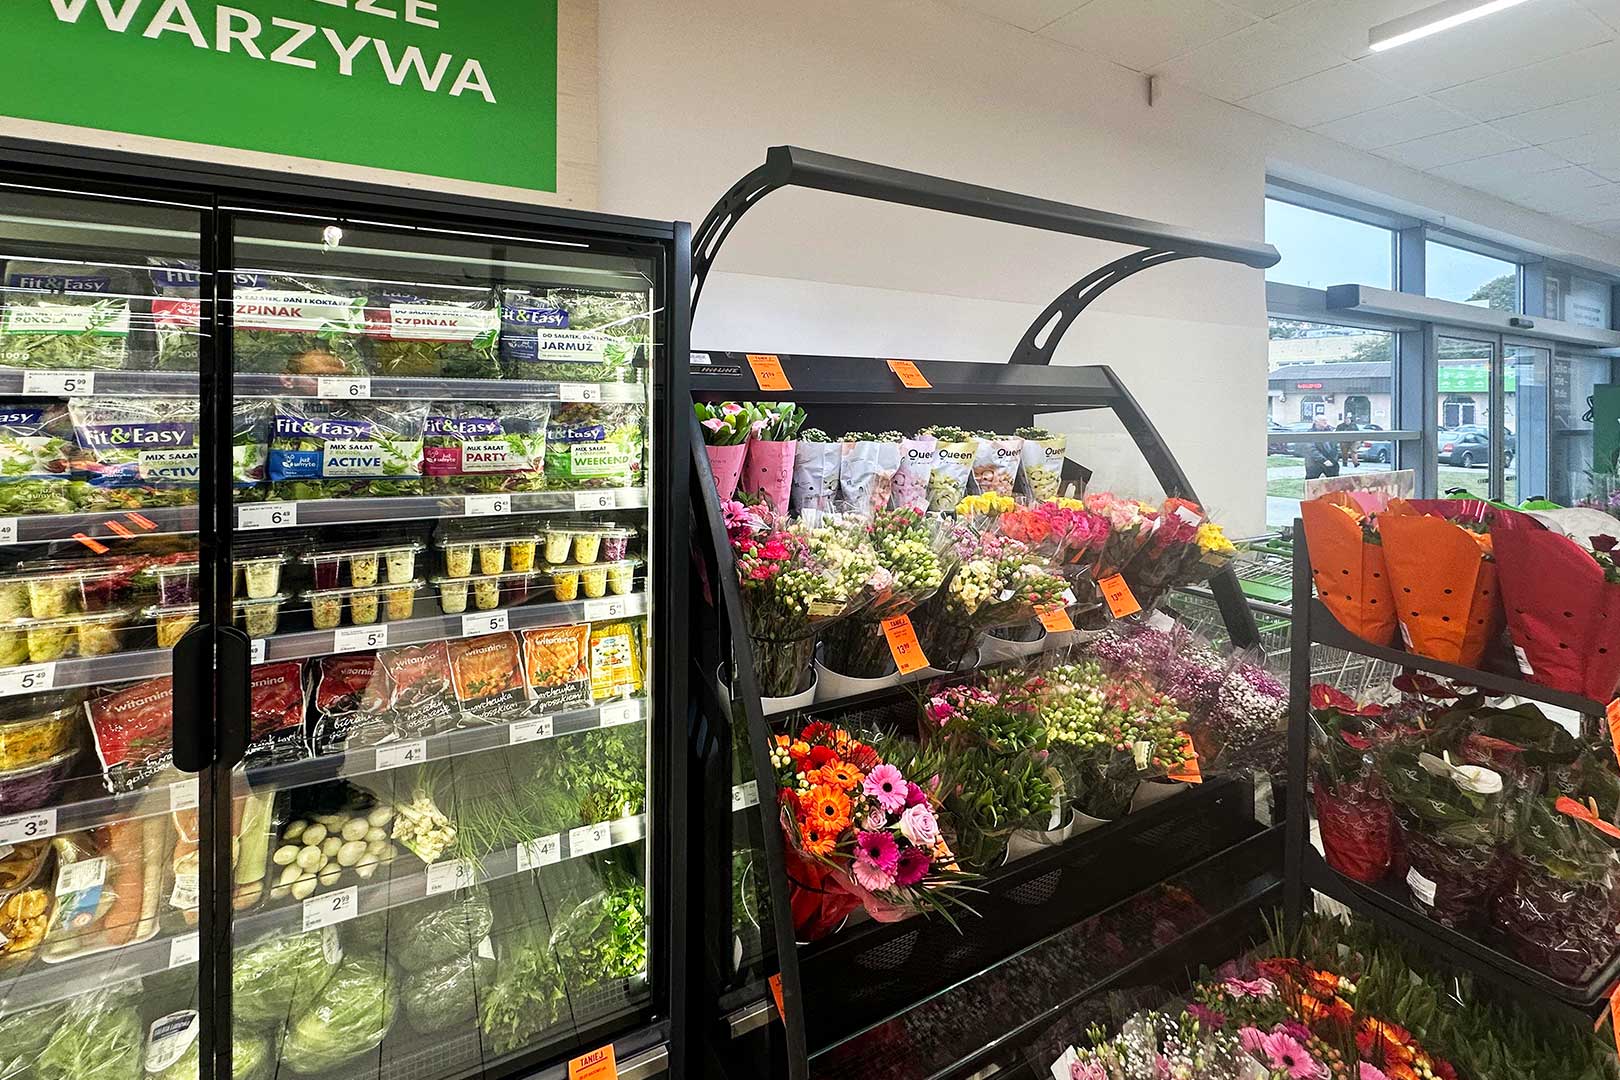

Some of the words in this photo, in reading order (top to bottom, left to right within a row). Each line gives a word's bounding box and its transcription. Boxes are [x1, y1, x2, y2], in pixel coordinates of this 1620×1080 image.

[235, 304, 303, 318] ZPINAK
[541, 341, 593, 352] JARMUŻ
[465, 453, 507, 462] PARTY
[939, 449, 972, 460] Queen
[327, 457, 381, 467] ACTIVE
[575, 456, 629, 466] WEEKEND
[147, 467, 199, 477] ACTIV
[580, 1050, 604, 1067] TANIEJ
